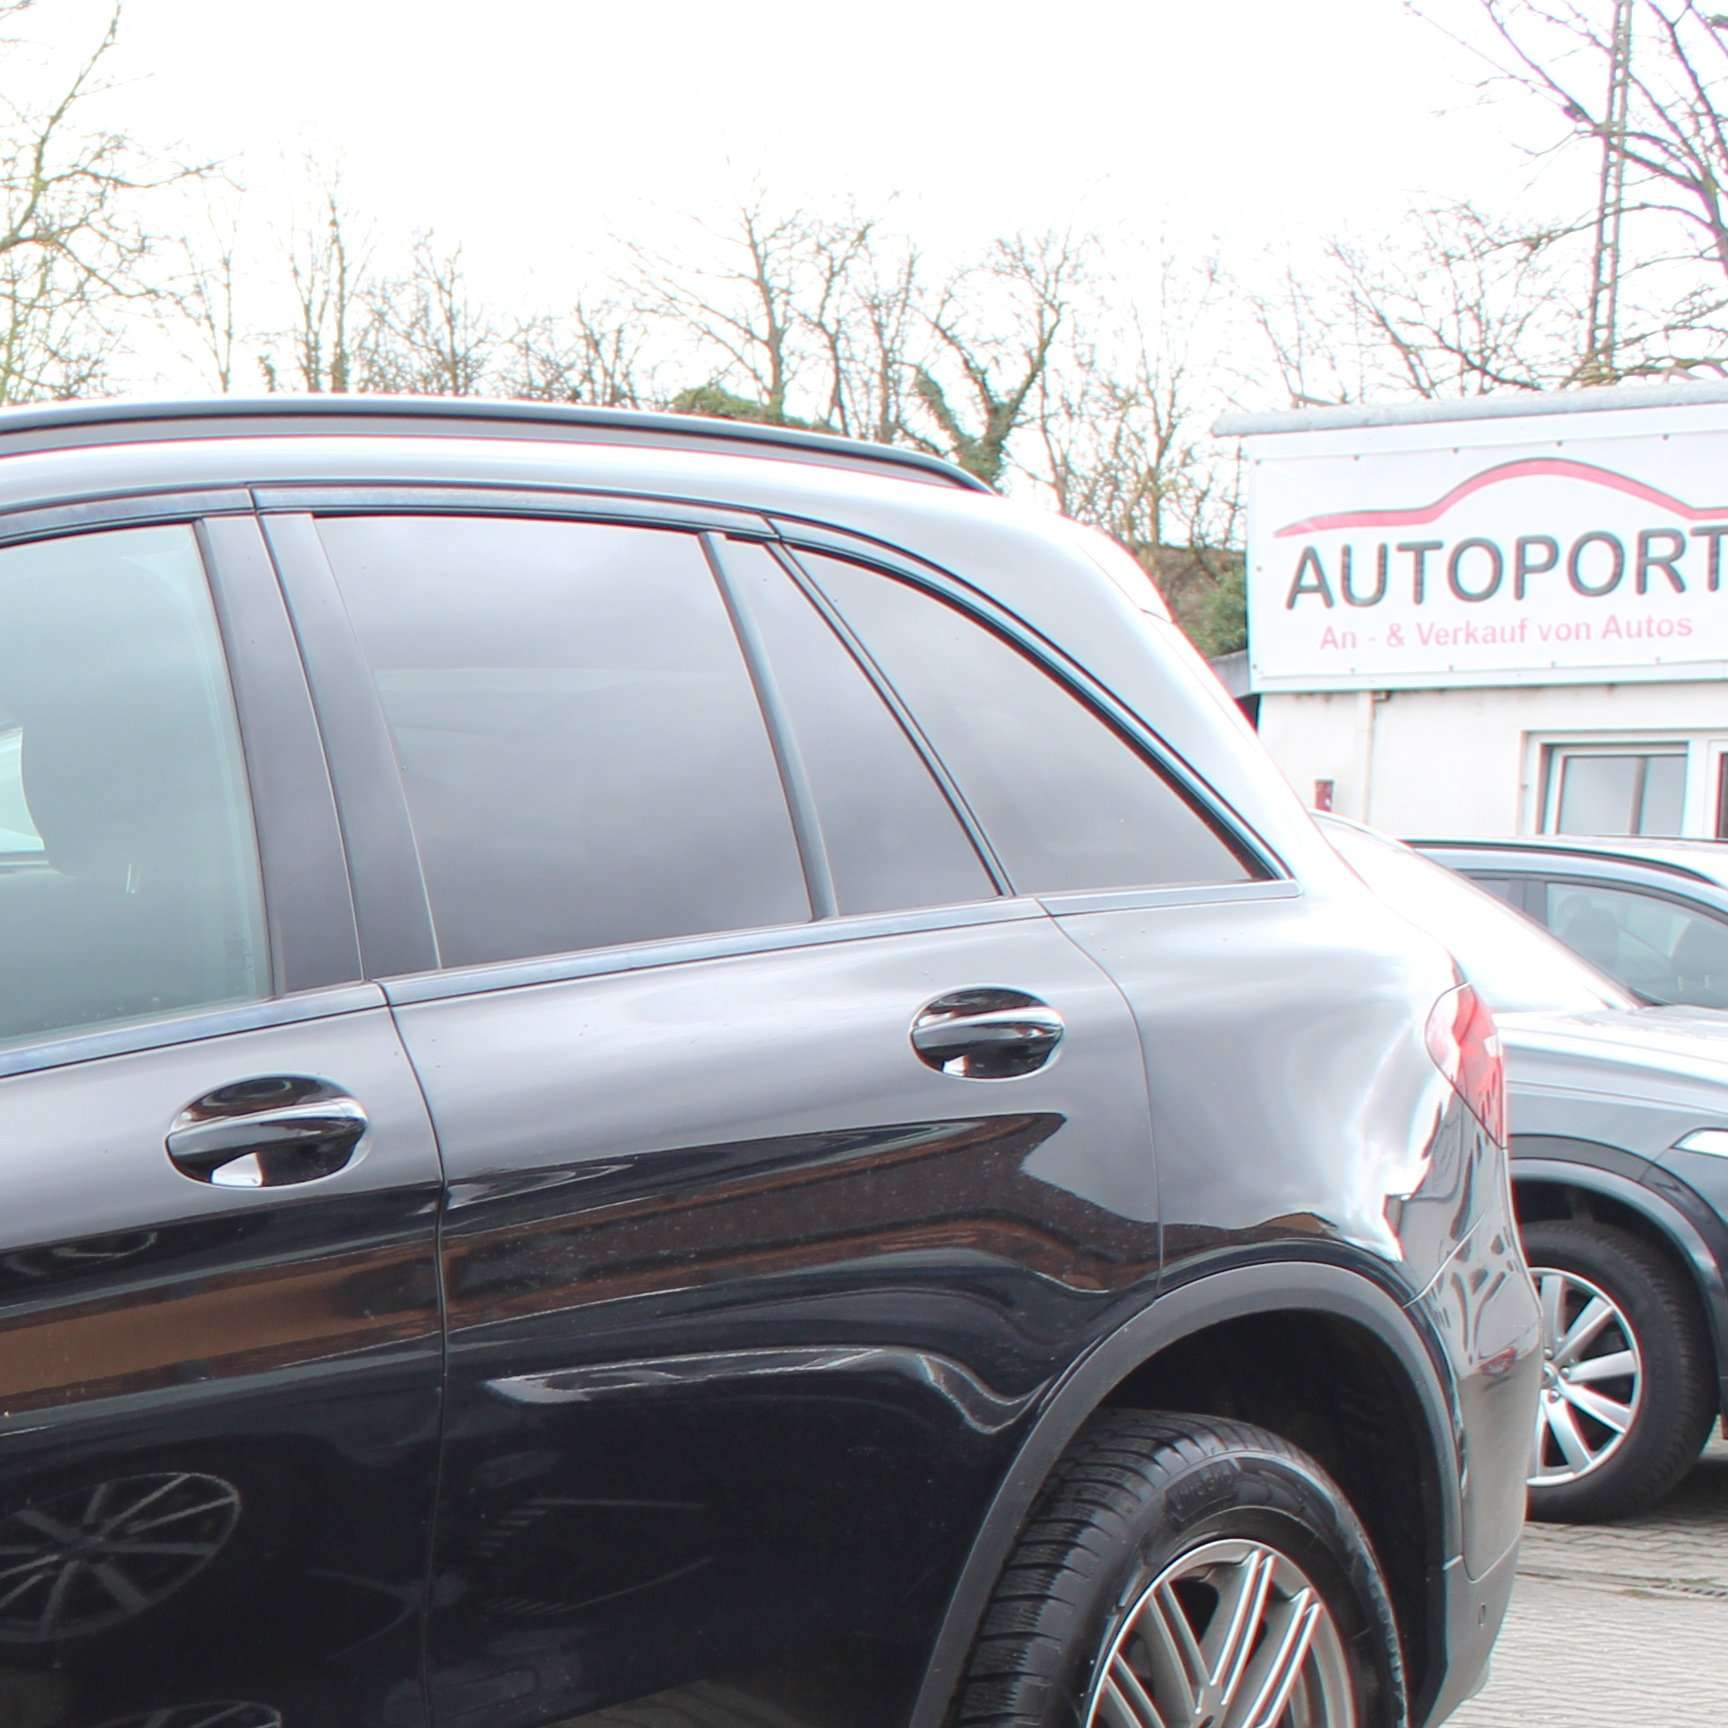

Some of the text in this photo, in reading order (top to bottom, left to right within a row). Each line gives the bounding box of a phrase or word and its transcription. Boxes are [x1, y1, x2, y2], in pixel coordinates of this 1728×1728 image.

[1285, 525, 1728, 610] AUTOPORT
[1386, 623, 1406, 648] &
[1416, 617, 1528, 648] Verkauf
[1538, 622, 1592, 643] von
[1600, 612, 1694, 641] Autos
